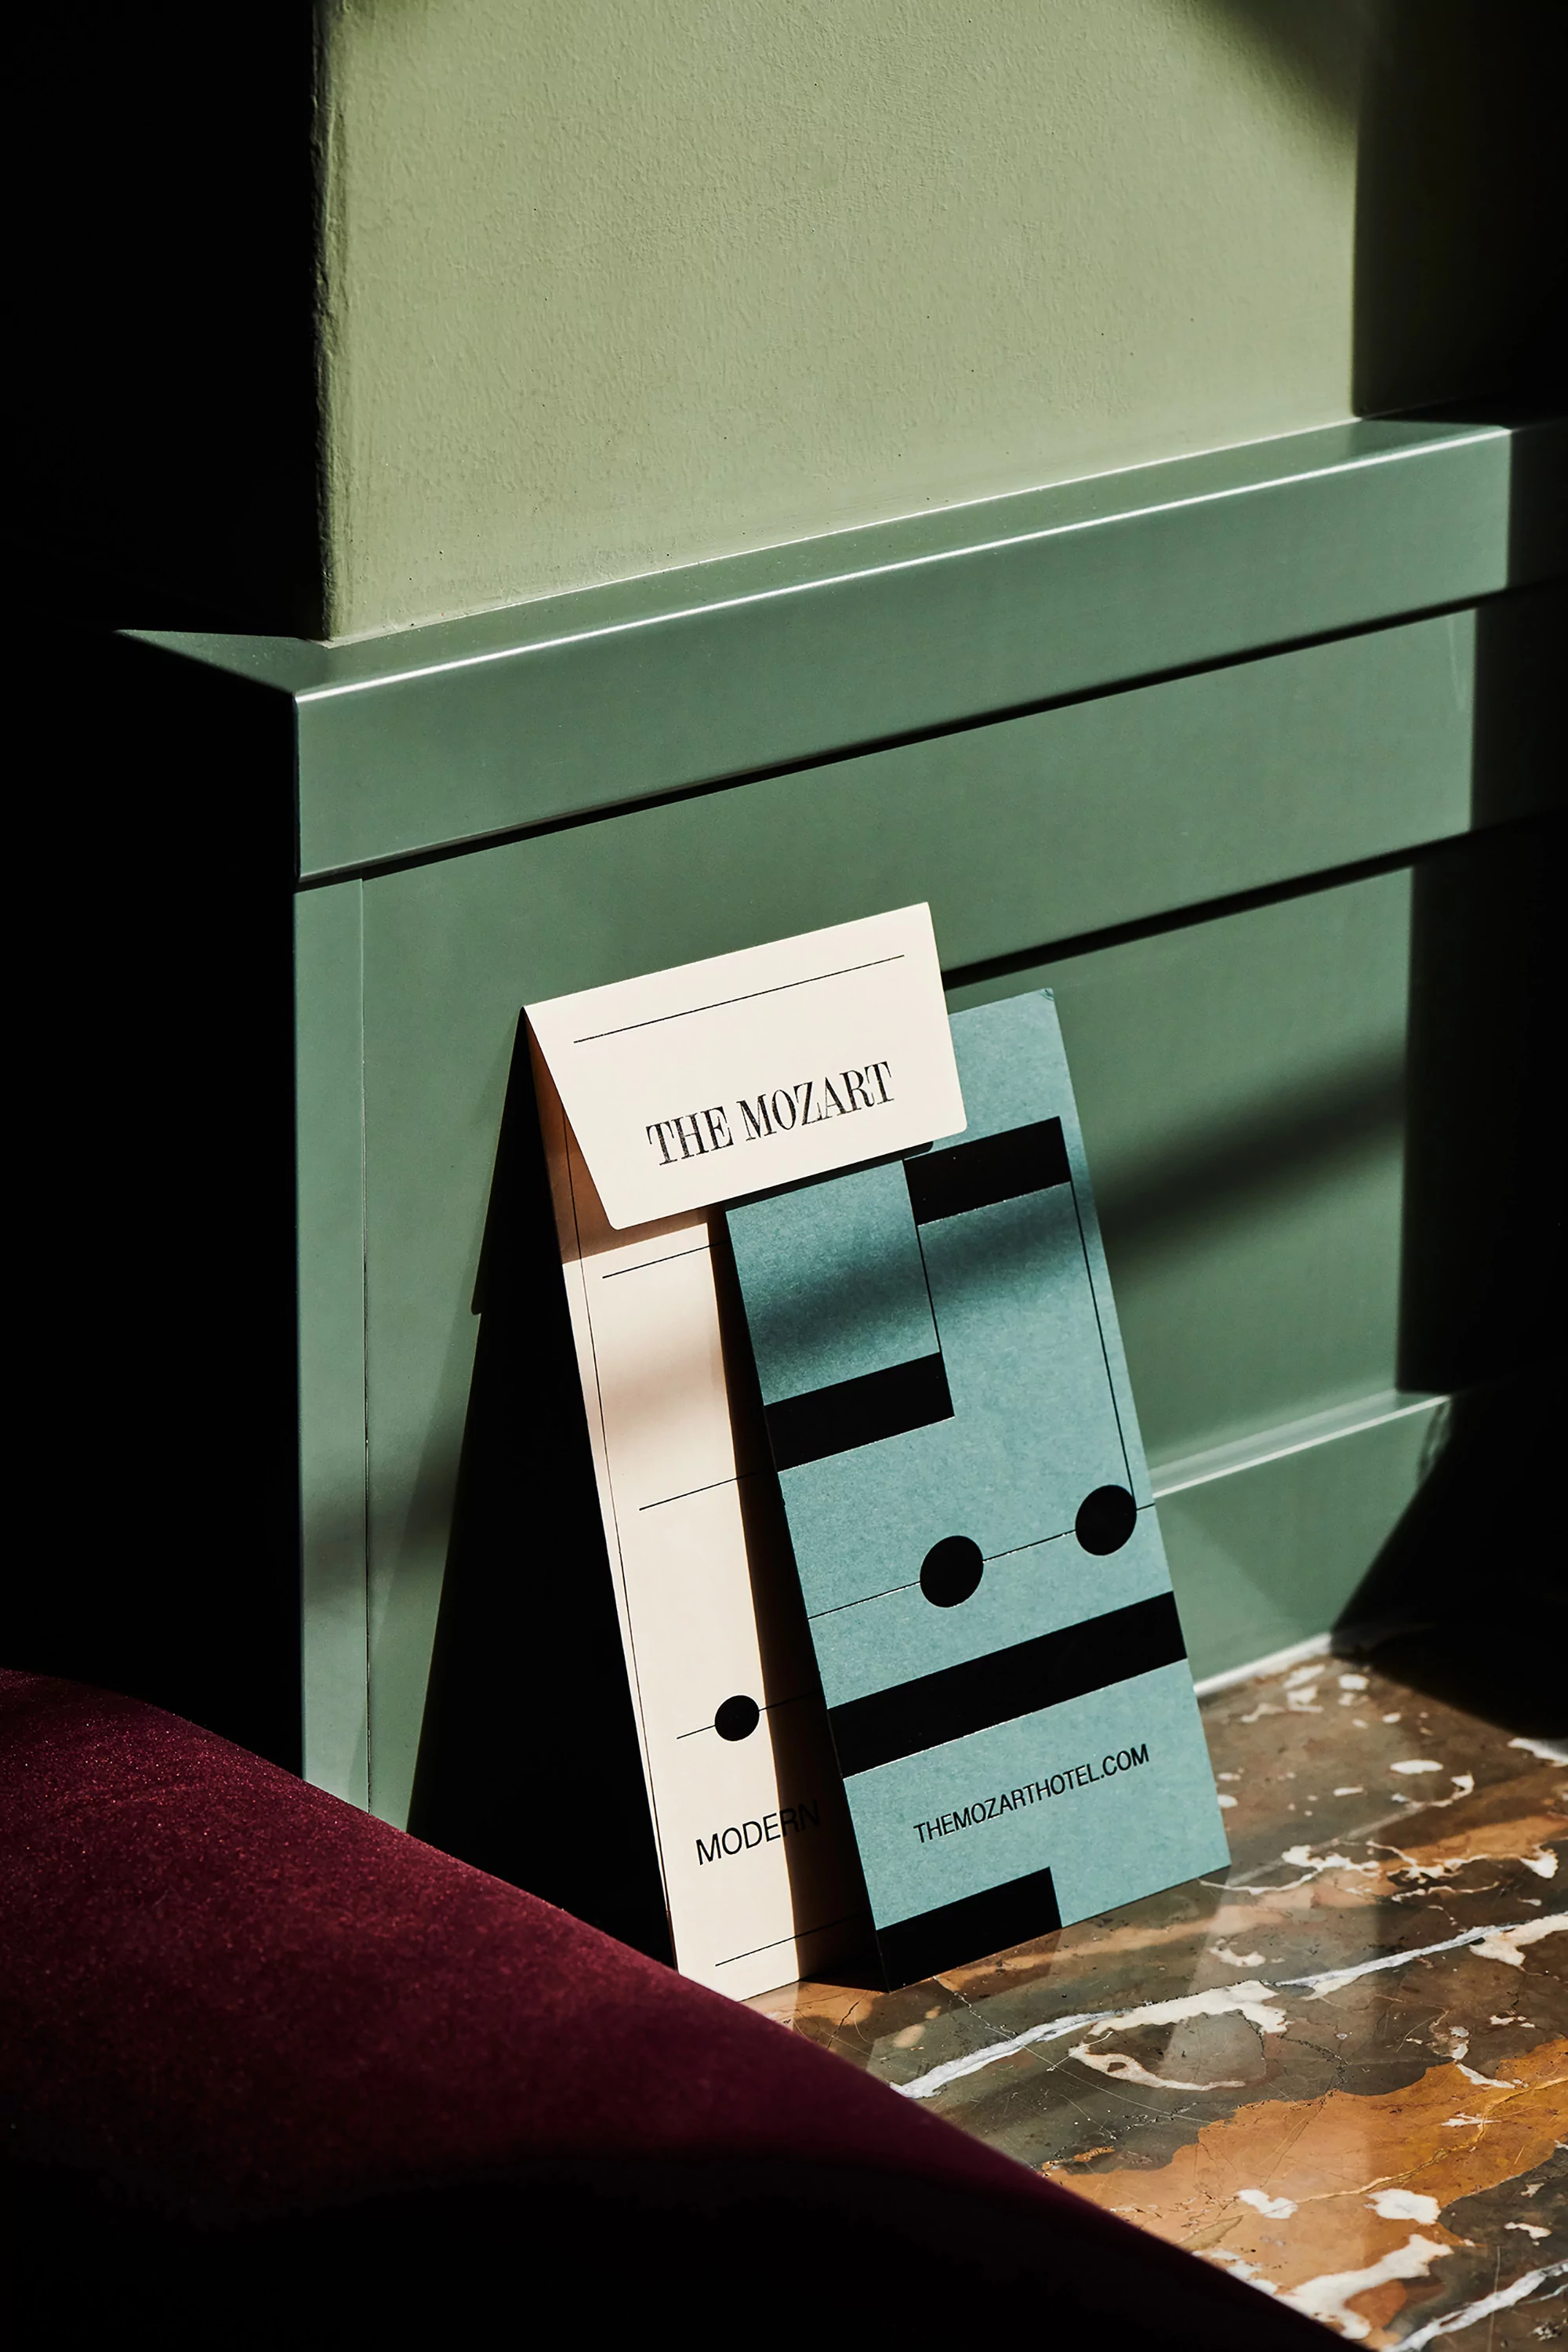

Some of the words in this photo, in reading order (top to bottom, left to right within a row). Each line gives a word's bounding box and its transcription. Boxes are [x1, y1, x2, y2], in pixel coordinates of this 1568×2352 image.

[647, 1106, 734, 1165] THE
[737, 1062, 894, 1142] MOZART
[696, 1802, 821, 1865] MODERN
[913, 1744, 1149, 1843] THEMOZARTHOTEL.COM
